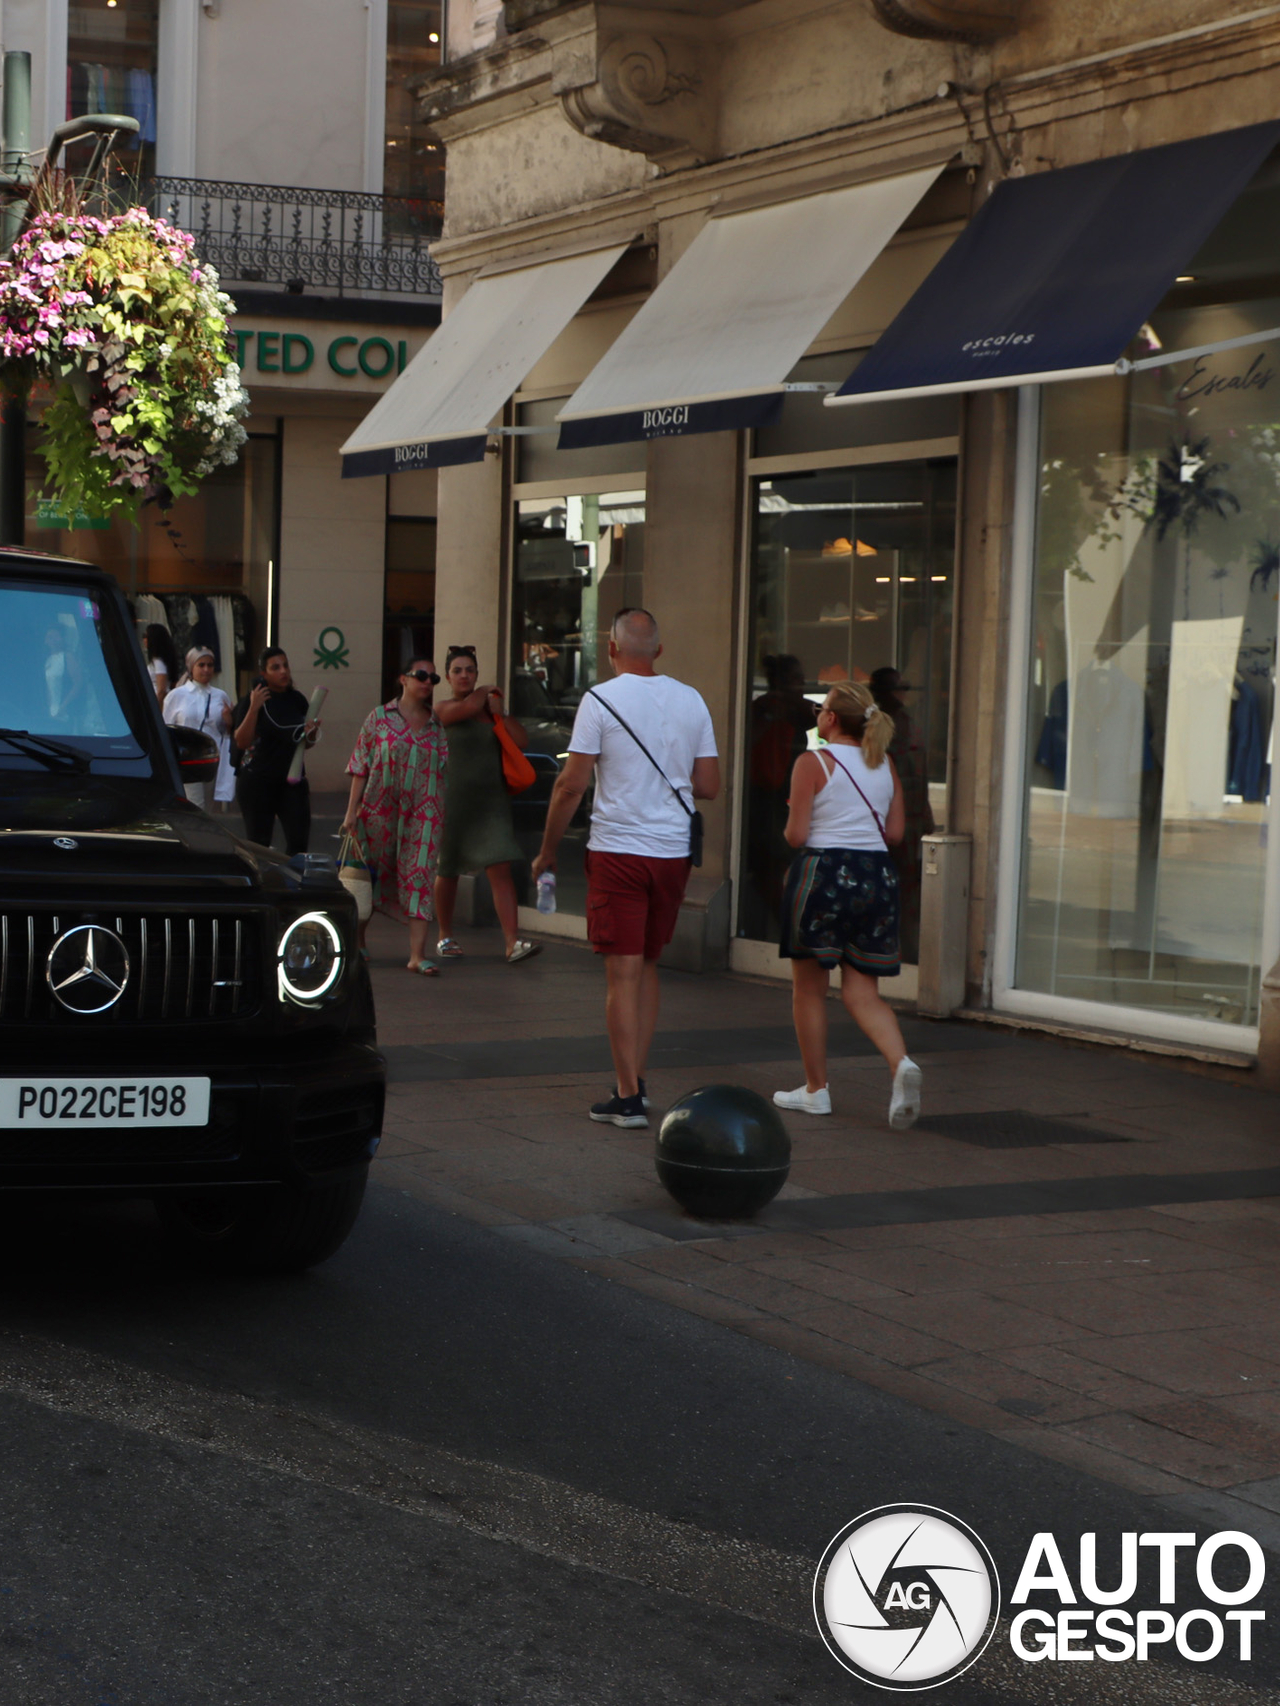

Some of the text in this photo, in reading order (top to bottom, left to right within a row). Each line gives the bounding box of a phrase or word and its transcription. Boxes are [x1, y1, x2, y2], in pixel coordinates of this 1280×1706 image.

[233, 329, 407, 378] TED COL
[961, 332, 1035, 351] escales
[1175, 352, 1277, 402] Escales
[642, 405, 689, 429] BOGGI
[394, 443, 429, 463] BOGGI
